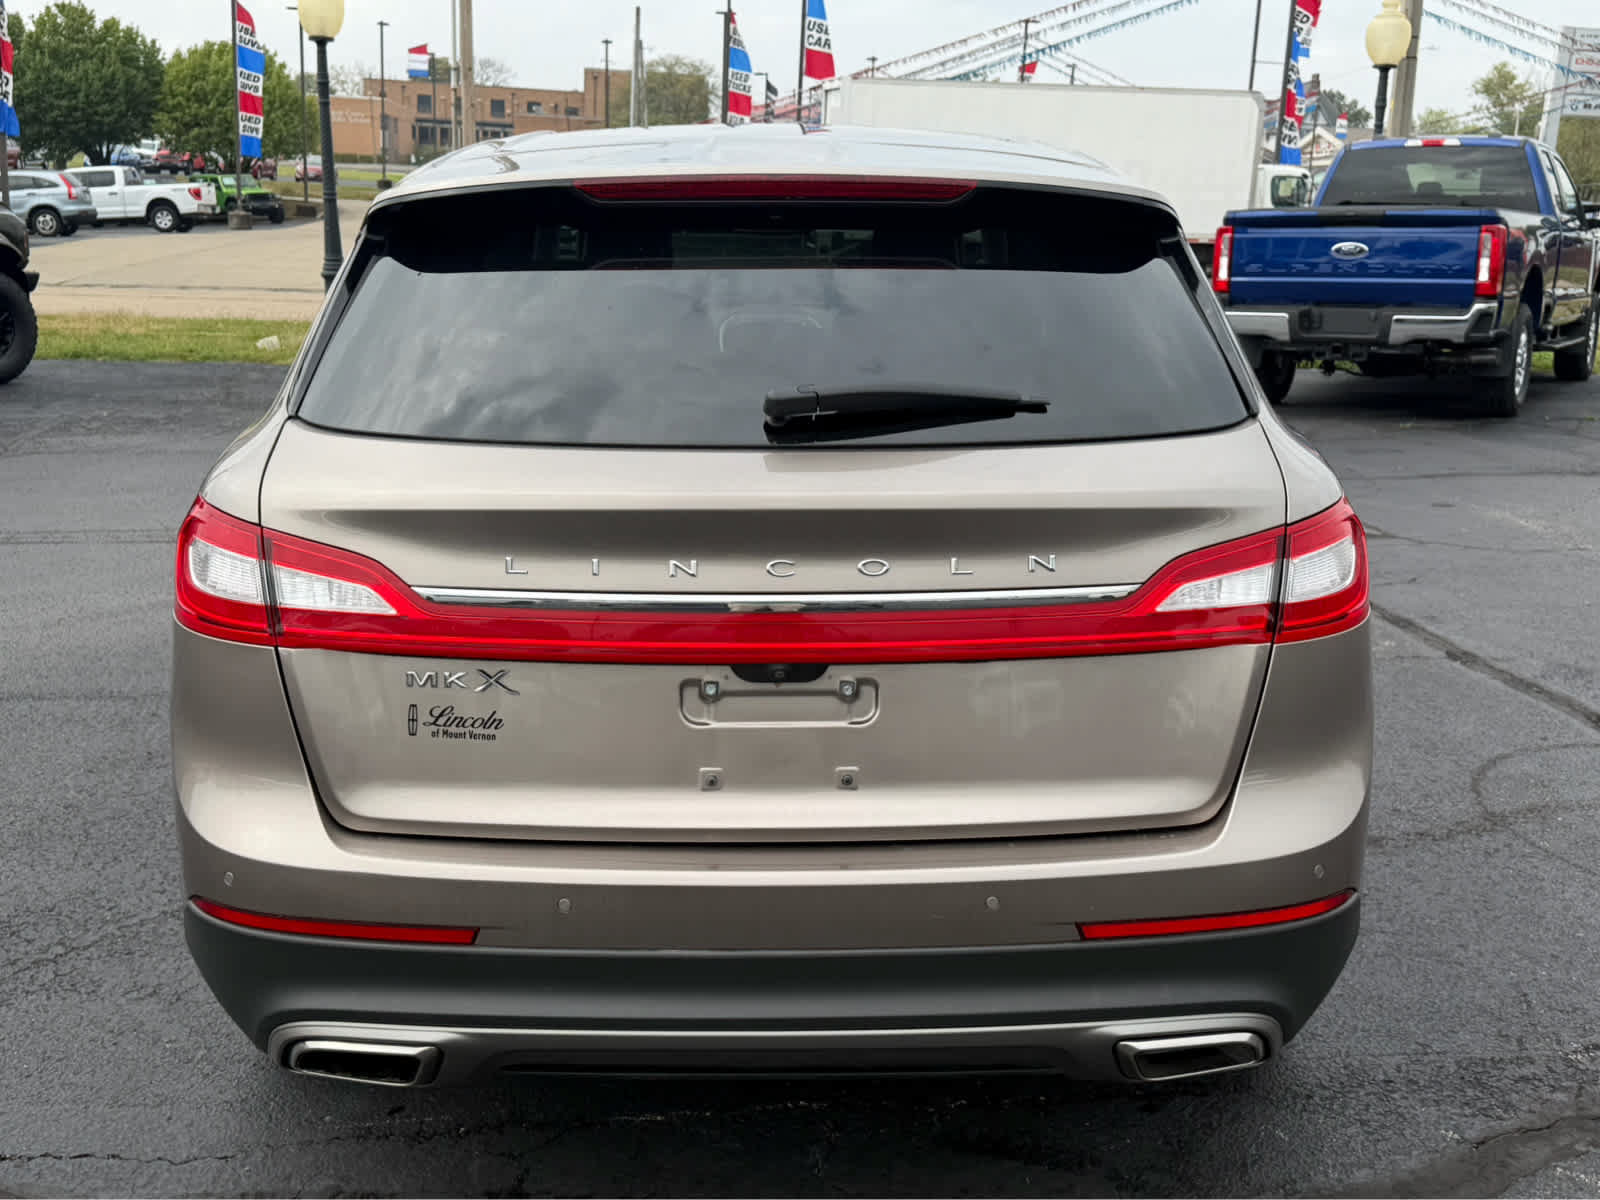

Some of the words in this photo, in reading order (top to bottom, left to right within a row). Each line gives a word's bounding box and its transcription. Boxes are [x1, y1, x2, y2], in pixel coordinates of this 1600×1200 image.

[505, 555, 1056, 578] LINCOLN
[406, 669, 520, 696] MKX
[422, 705, 505, 730] Lincoln
[431, 728, 440, 738] of
[442, 728, 467, 740] Mount
[468, 730, 496, 741] Vernon
